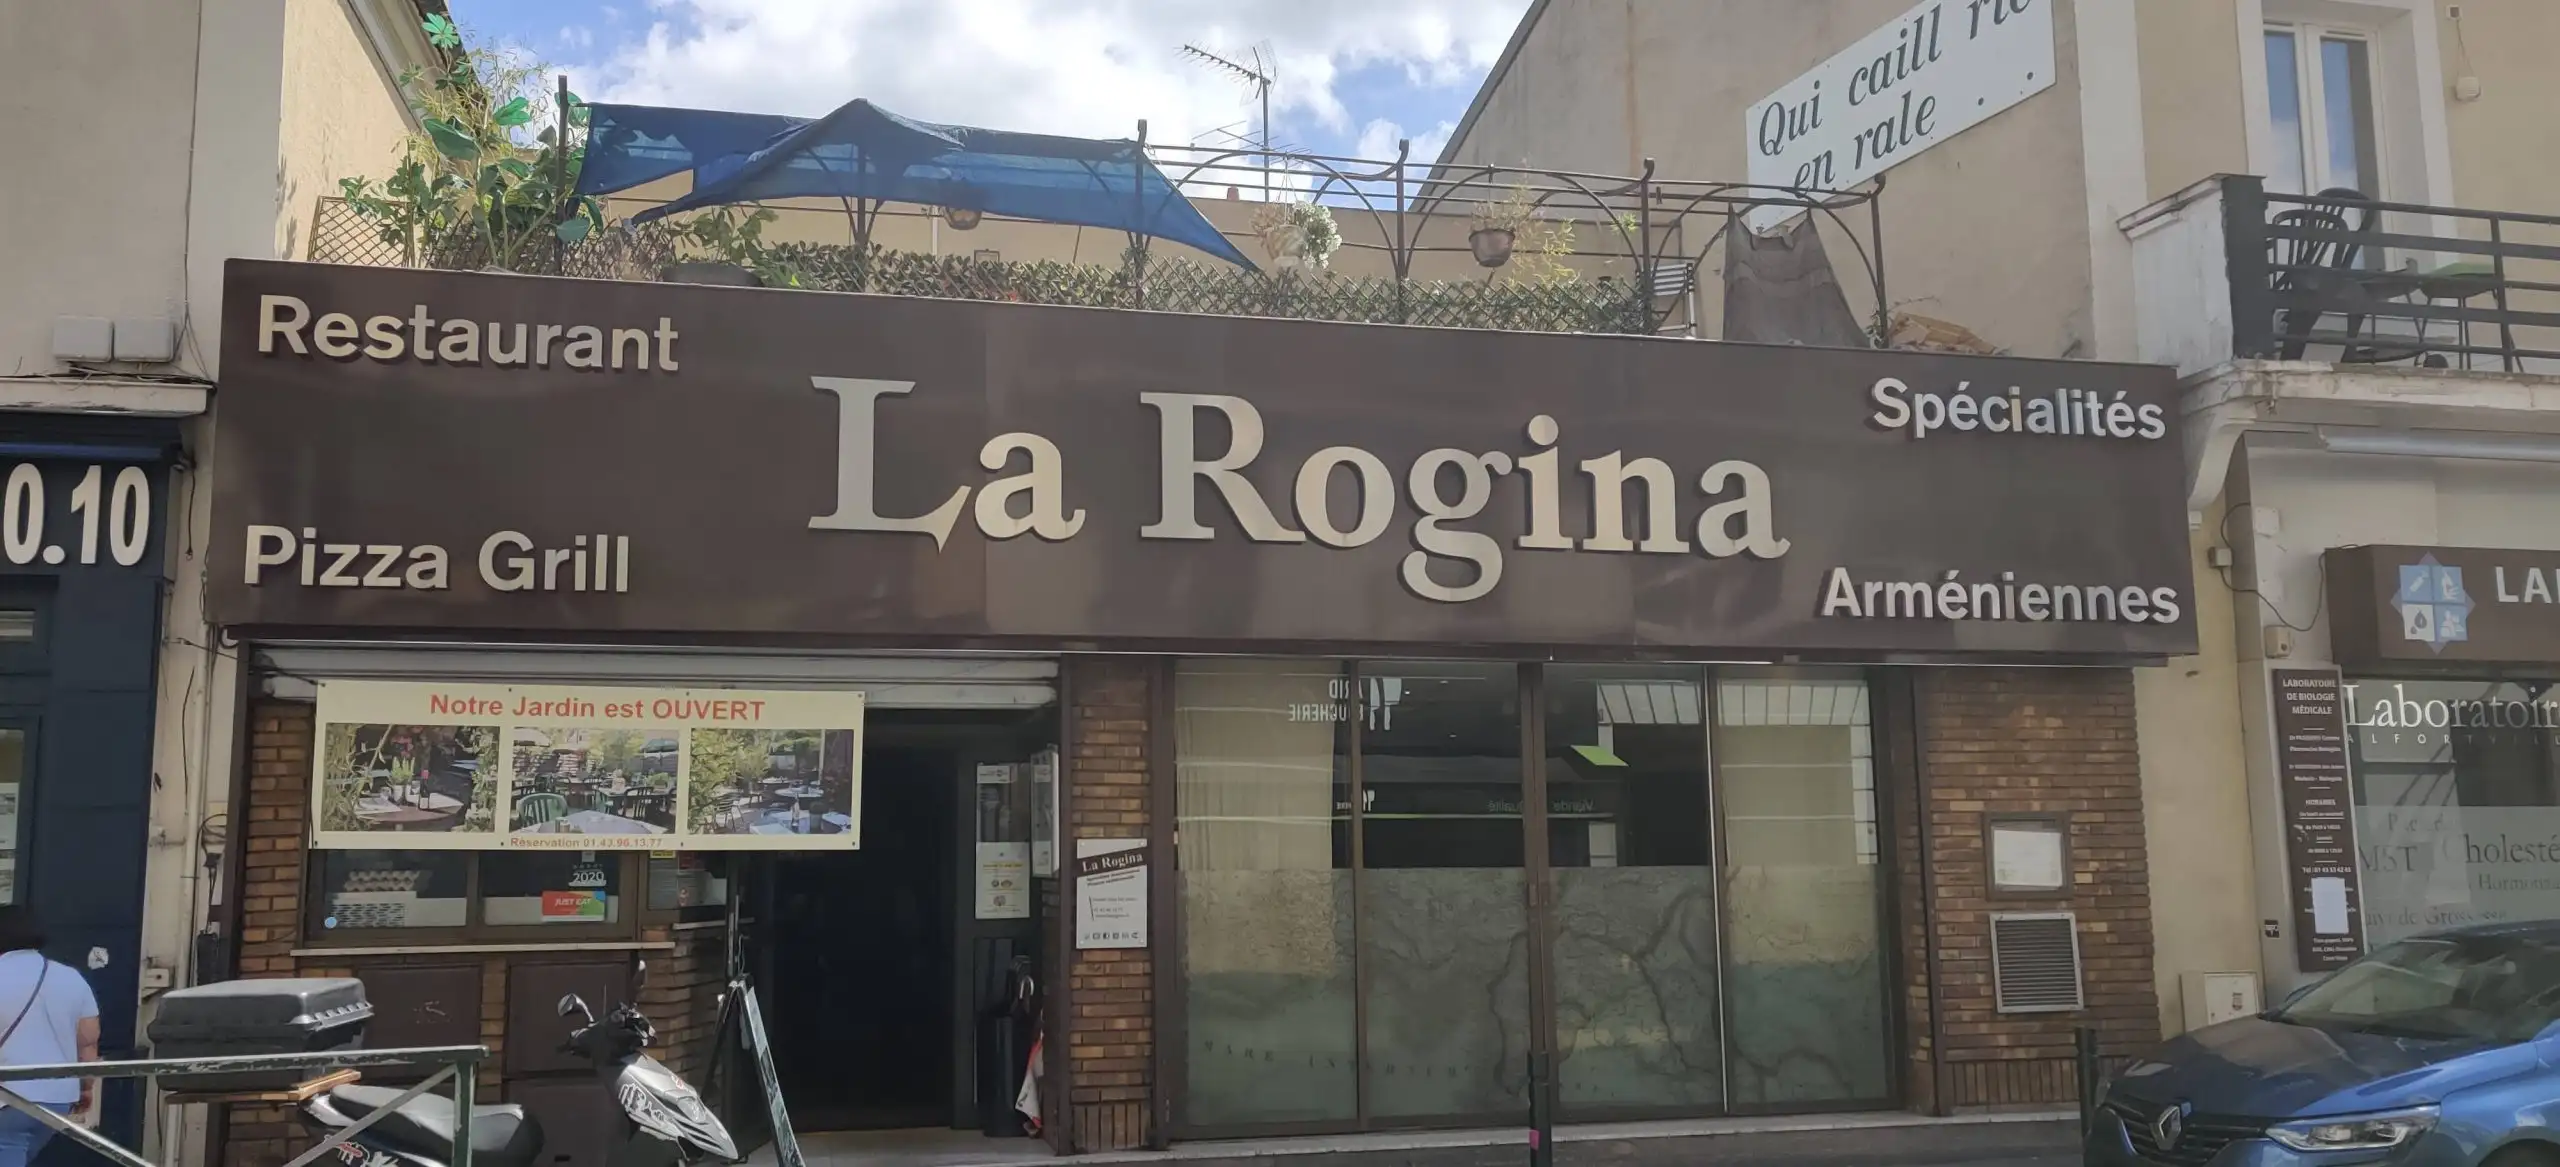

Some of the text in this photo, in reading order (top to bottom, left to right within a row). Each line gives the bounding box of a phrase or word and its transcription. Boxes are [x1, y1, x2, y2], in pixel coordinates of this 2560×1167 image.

[1759, 80, 1823, 156] Qui
[1849, 3, 1942, 107] caill
[1794, 90, 1936, 198] en rale
[258, 294, 679, 371] Restaurant
[1871, 377, 2167, 439] Spécialités
[807, 376, 1791, 602] La Rogina
[243, 524, 630, 592] Pizza Grill
[2495, 565, 2560, 604] LA
[1820, 566, 2181, 624] Arméniennes
[430, 694, 765, 720] Notre Jardin est OUVERT
[571, 870, 605, 884] 2020
[1082, 852, 1144, 873] La Rogina
